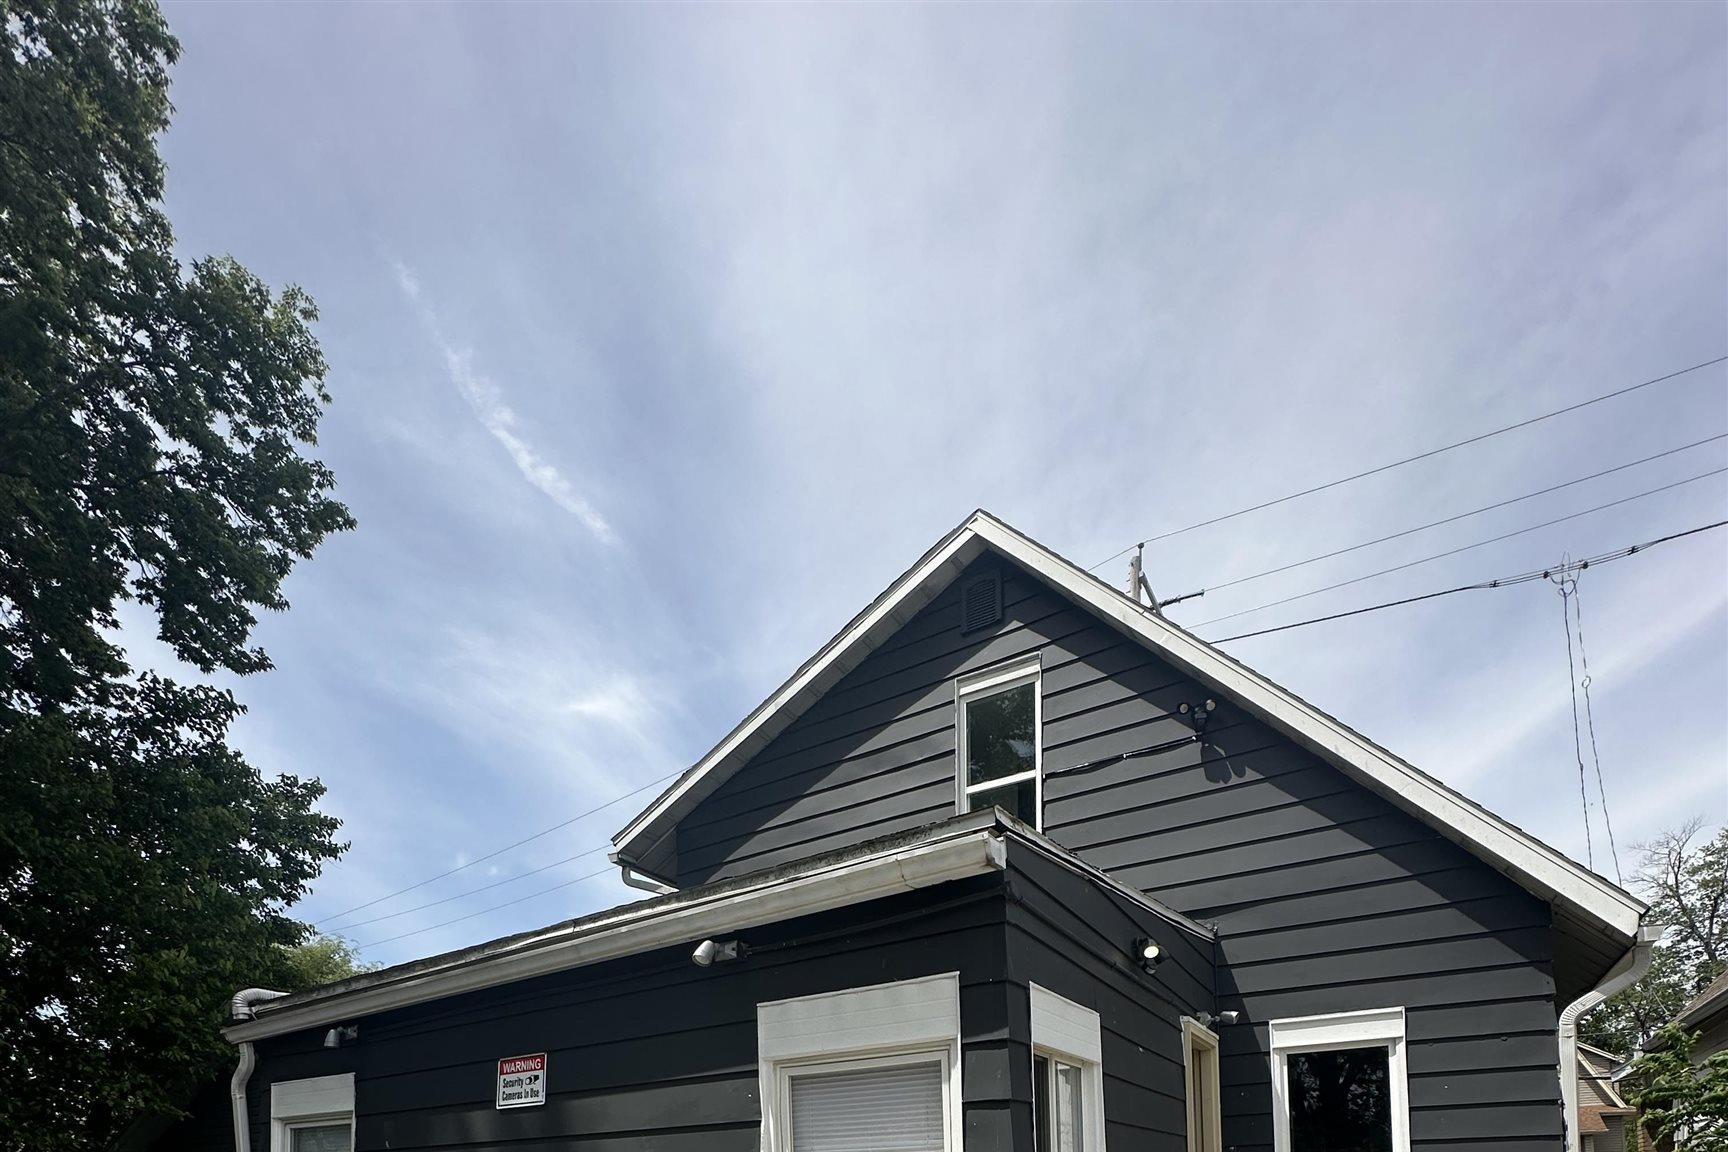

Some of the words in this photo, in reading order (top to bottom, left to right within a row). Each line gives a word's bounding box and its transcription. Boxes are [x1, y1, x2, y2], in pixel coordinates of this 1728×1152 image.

[503, 1058, 542, 1074] WARNING
[503, 1077, 524, 1088] Security
[502, 1091, 523, 1101] Cameras
[530, 1088, 539, 1098] Use
